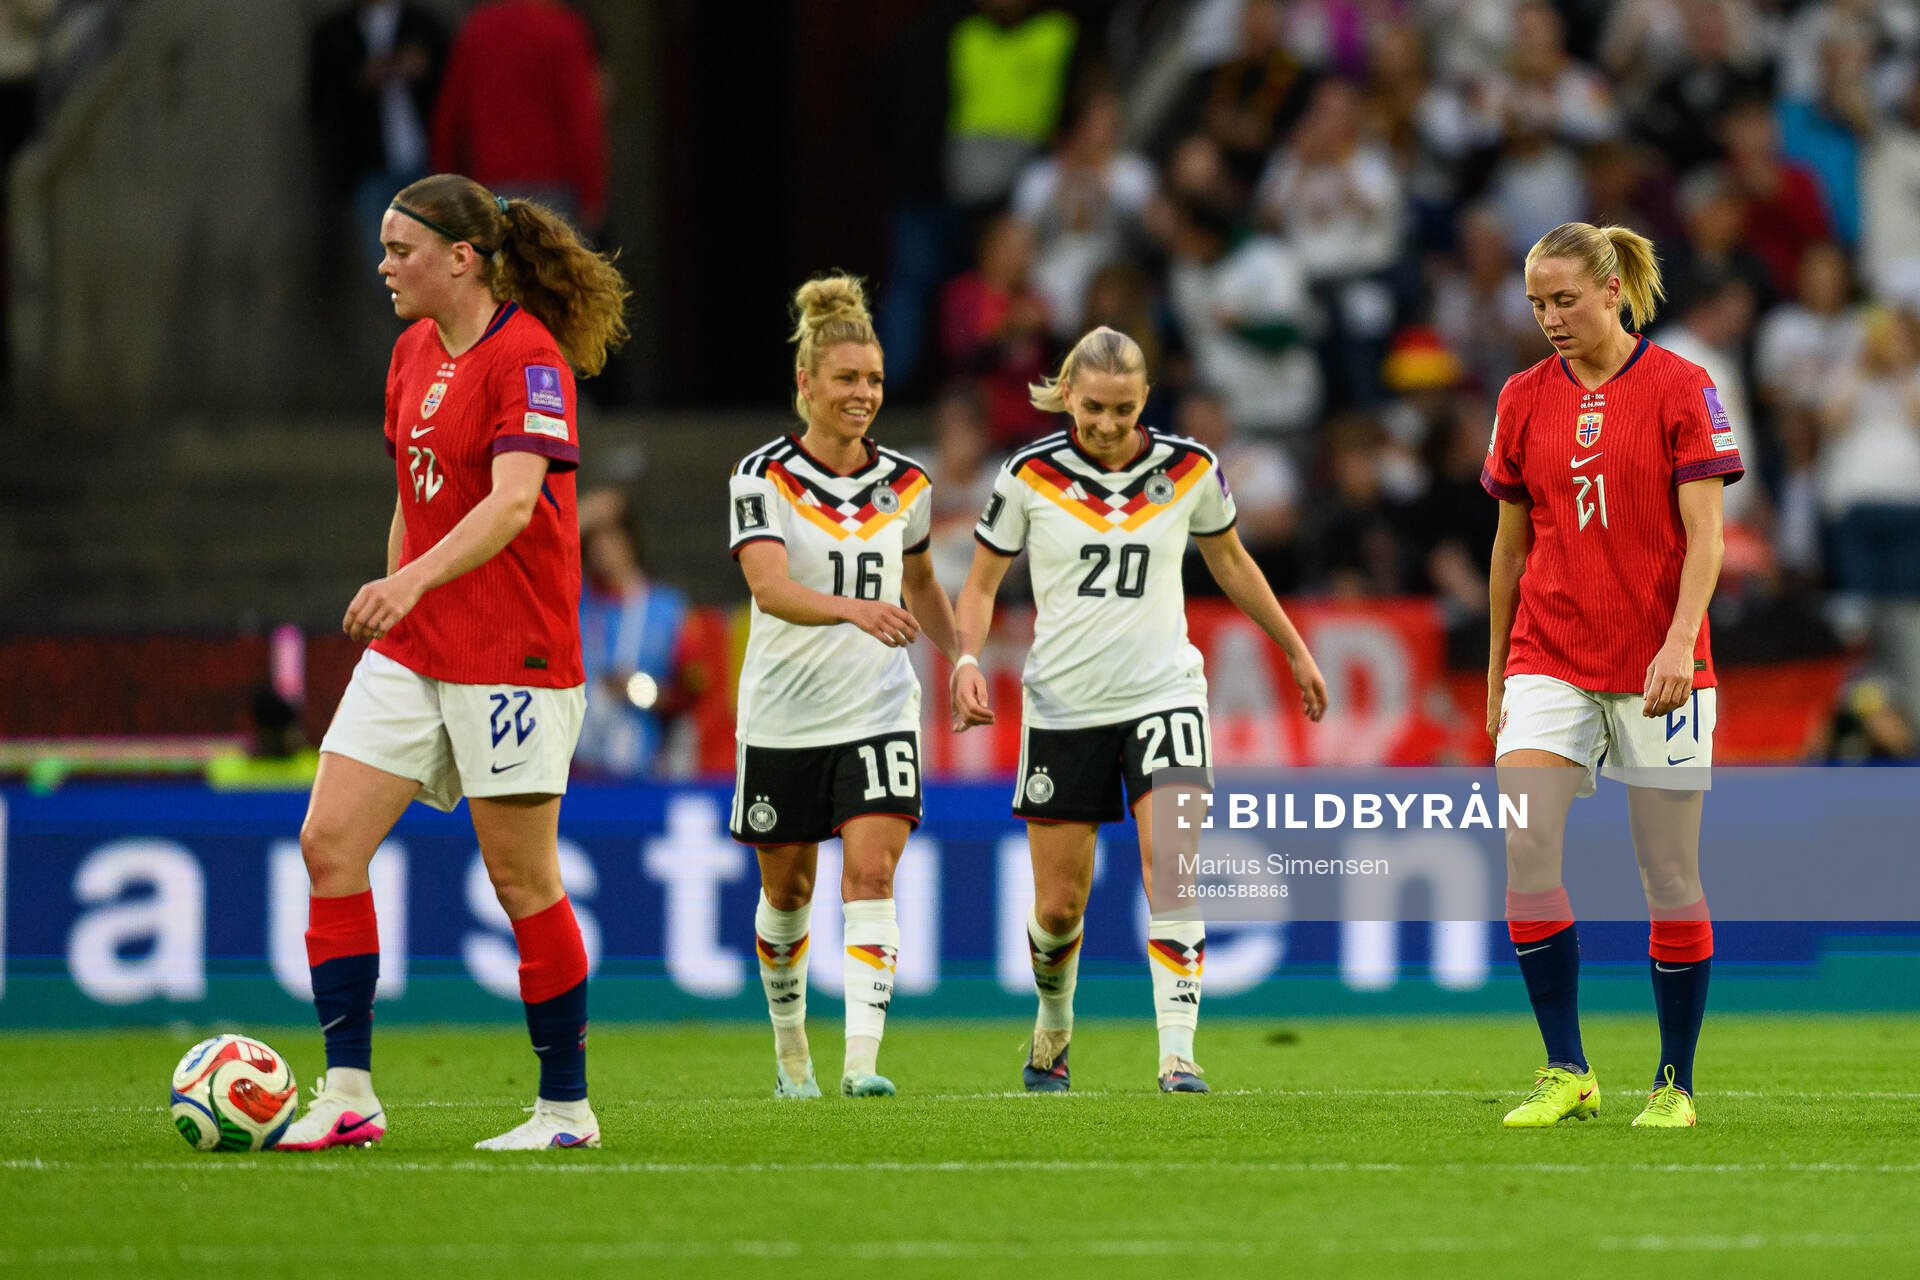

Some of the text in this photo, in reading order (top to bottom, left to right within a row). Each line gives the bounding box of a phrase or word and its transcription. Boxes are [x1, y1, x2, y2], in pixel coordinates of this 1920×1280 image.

[407, 445, 445, 504] 22
[1572, 473, 1609, 532] 21
[828, 550, 885, 601] 16
[1077, 543, 1151, 599] 20
[489, 690, 536, 750] 22
[1136, 711, 1203, 776] 20
[857, 740, 917, 801] 16
